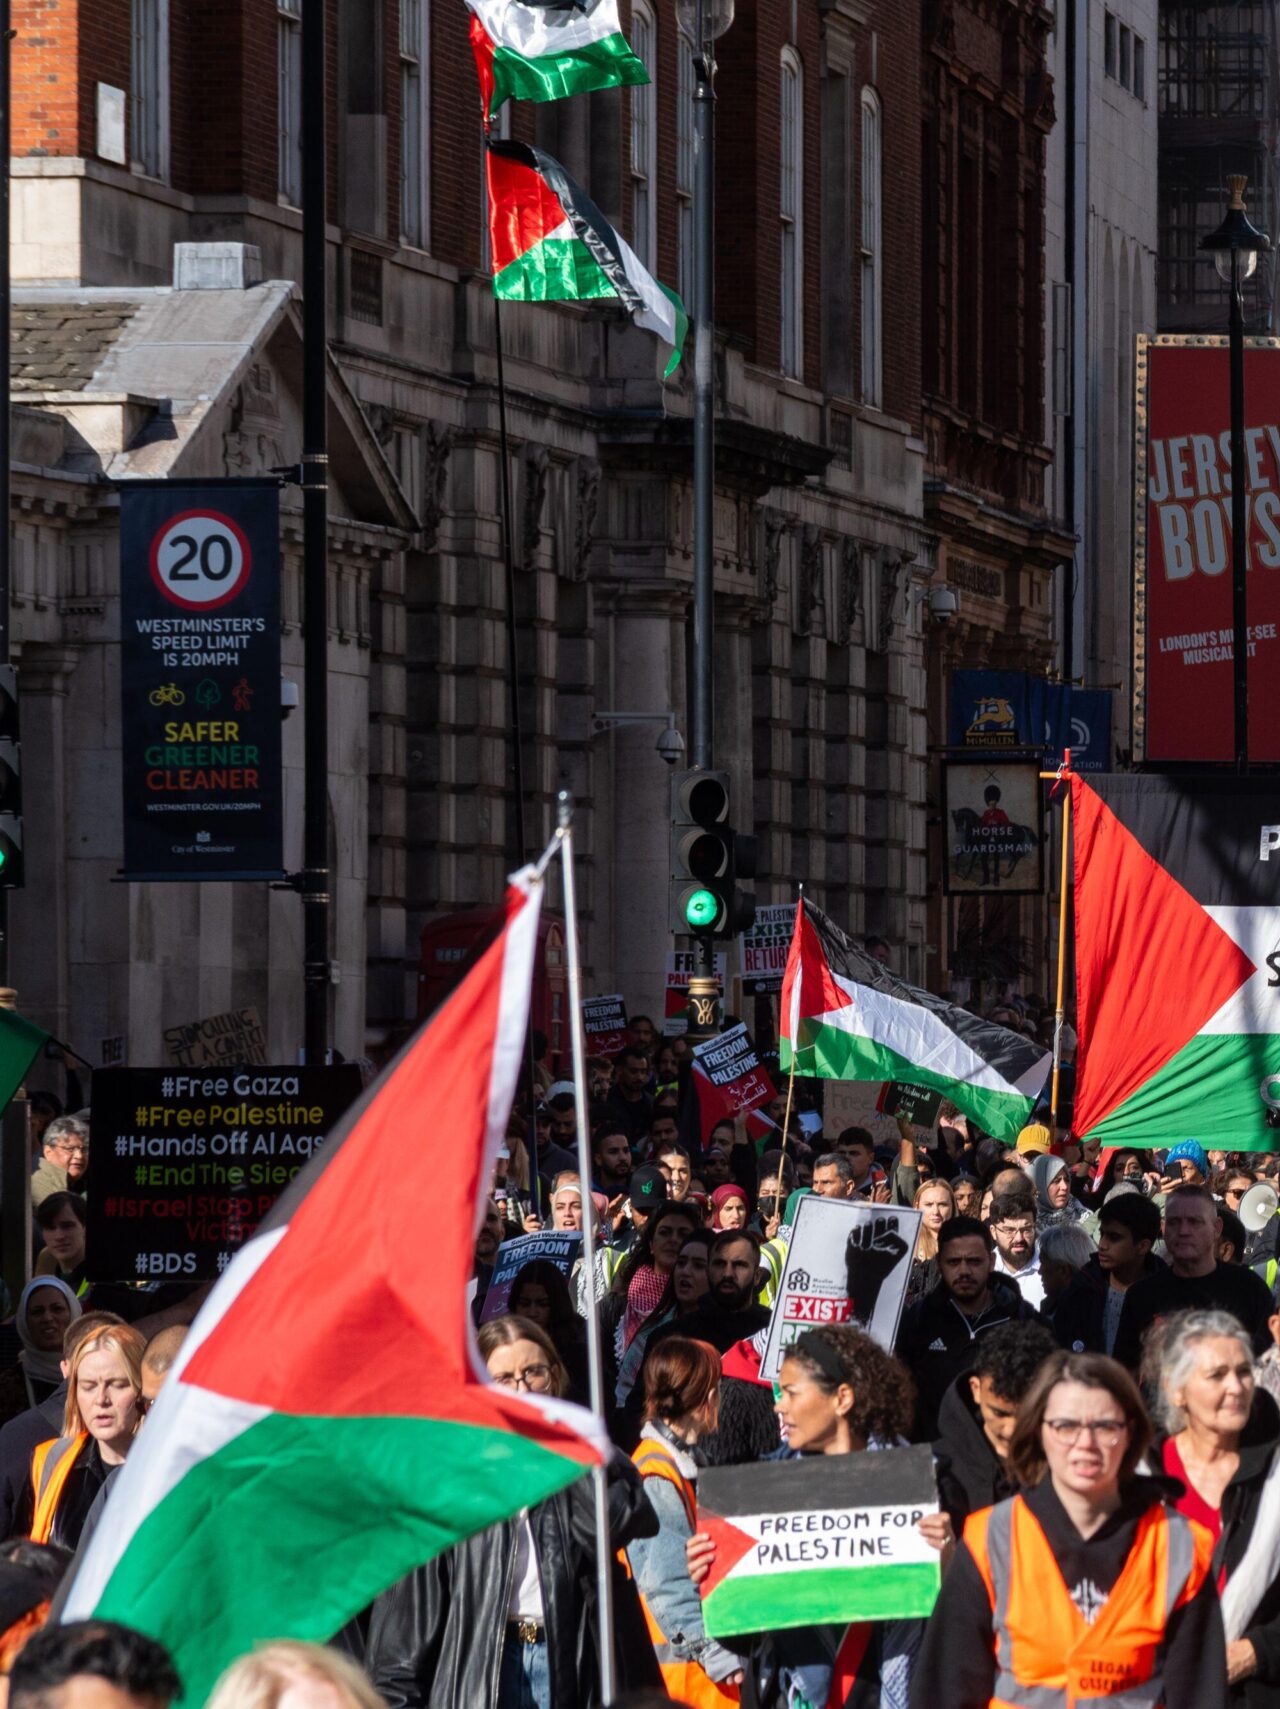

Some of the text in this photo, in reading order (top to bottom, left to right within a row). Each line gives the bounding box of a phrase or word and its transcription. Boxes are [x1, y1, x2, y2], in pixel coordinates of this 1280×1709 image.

[168, 534, 233, 582] 20
[136, 618, 266, 634] WESTMINSTER'S
[152, 635, 250, 650] SPEED LIMIT
[1160, 624, 1276, 652] LONDON'S MT-SEE
[163, 652, 239, 667] IS 20MPH
[1184, 646, 1233, 665] MUSICAL
[164, 721, 240, 742] SAFER
[145, 744, 260, 767] GREENER
[147, 769, 260, 791] CLEANER
[146, 802, 261, 812] WESTMINSTER.GOV.UK/20MPH
[971, 827, 1014, 836] HORSE
[955, 843, 1033, 854] GUARDSMAN
[584, 1003, 622, 1019] FREEDOM
[586, 1018, 627, 1034] PALESTINE
[703, 1036, 749, 1068] FREEDOM
[711, 1052, 759, 1085] PALESTINE
[279, 1134, 325, 1158] Aqs
[135, 1252, 198, 1275] #BDS
[502, 1241, 571, 1264] FREEDOM
[785, 1298, 852, 1321] EXIST.
[760, 1510, 924, 1536] FREEDOM FOR
[757, 1537, 893, 1565] PALESTINE
[1091, 1660, 1133, 1675] LEGAL
